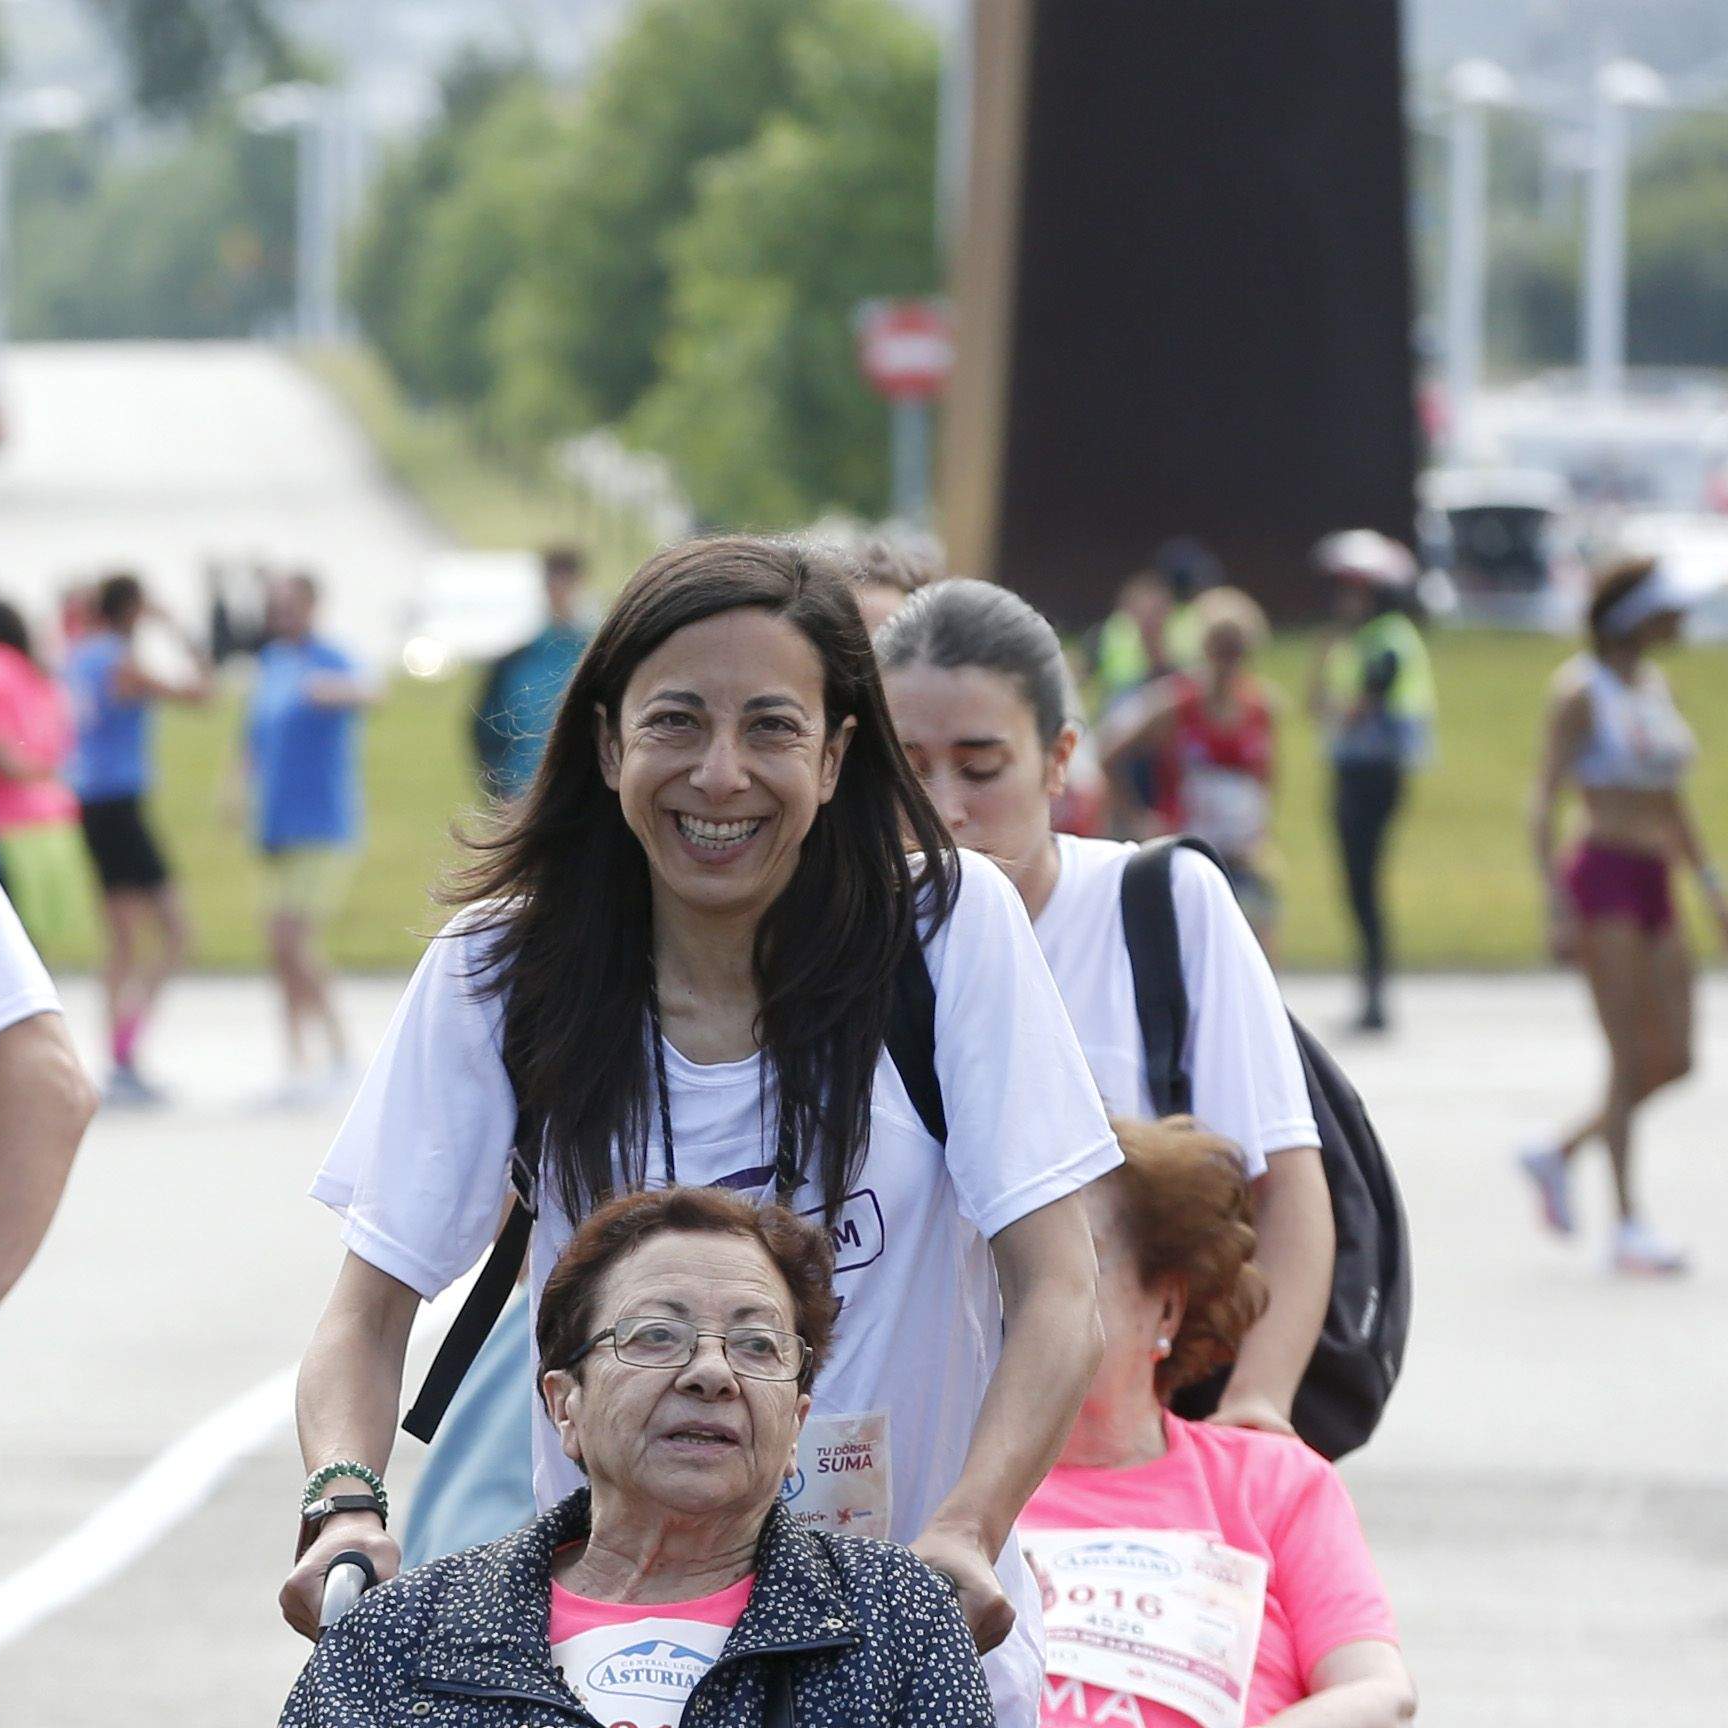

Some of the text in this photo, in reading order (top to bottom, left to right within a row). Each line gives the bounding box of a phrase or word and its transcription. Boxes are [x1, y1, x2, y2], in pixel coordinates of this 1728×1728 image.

[817, 1442, 873, 1457] TU DORSAL
[817, 1454, 874, 1474] SUMA
[1067, 1585, 1163, 1619] 016
[621, 1659, 669, 1668] CENTRAL
